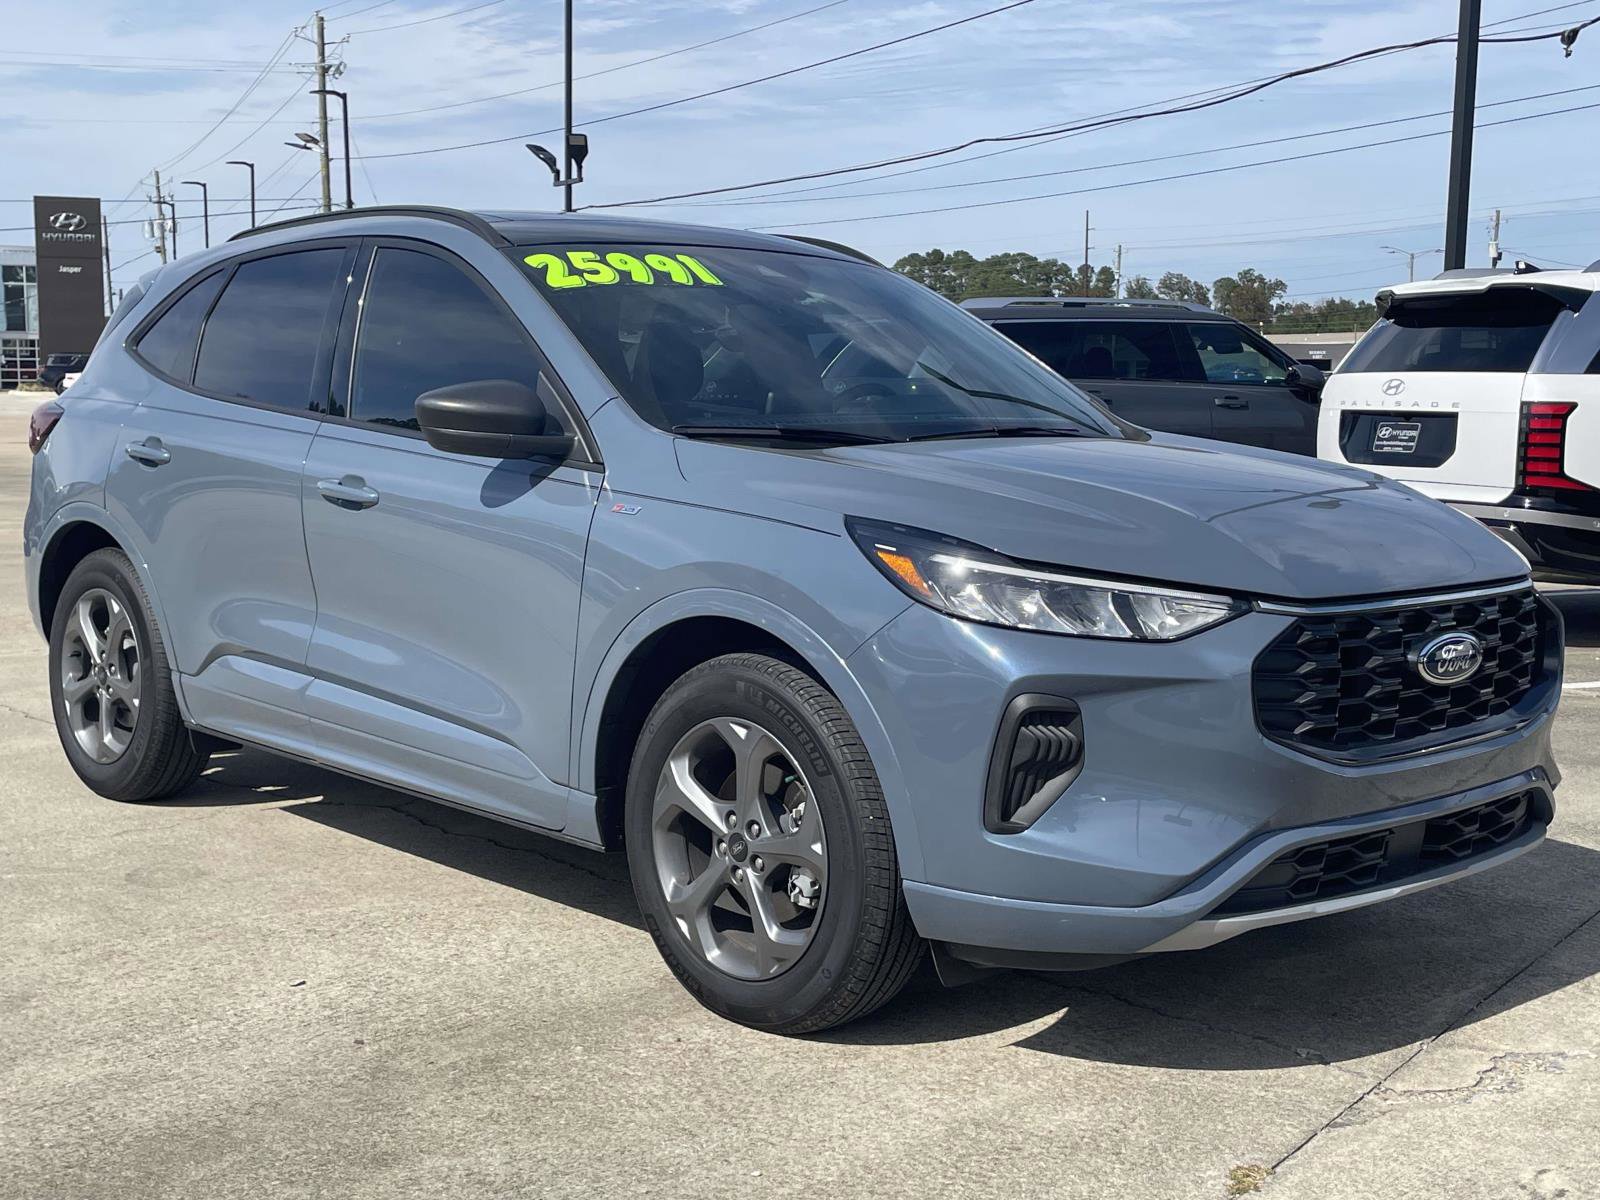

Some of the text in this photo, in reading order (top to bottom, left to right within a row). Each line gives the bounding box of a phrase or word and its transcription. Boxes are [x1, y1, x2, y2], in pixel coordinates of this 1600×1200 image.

[42, 232, 96, 242] HYUNDAI
[59, 265, 82, 274] Jasper
[523, 251, 725, 289] 25991
[1339, 400, 1461, 409] PALISADE
[1437, 644, 1473, 673] Ford
[765, 699, 831, 775] MICHELIN
